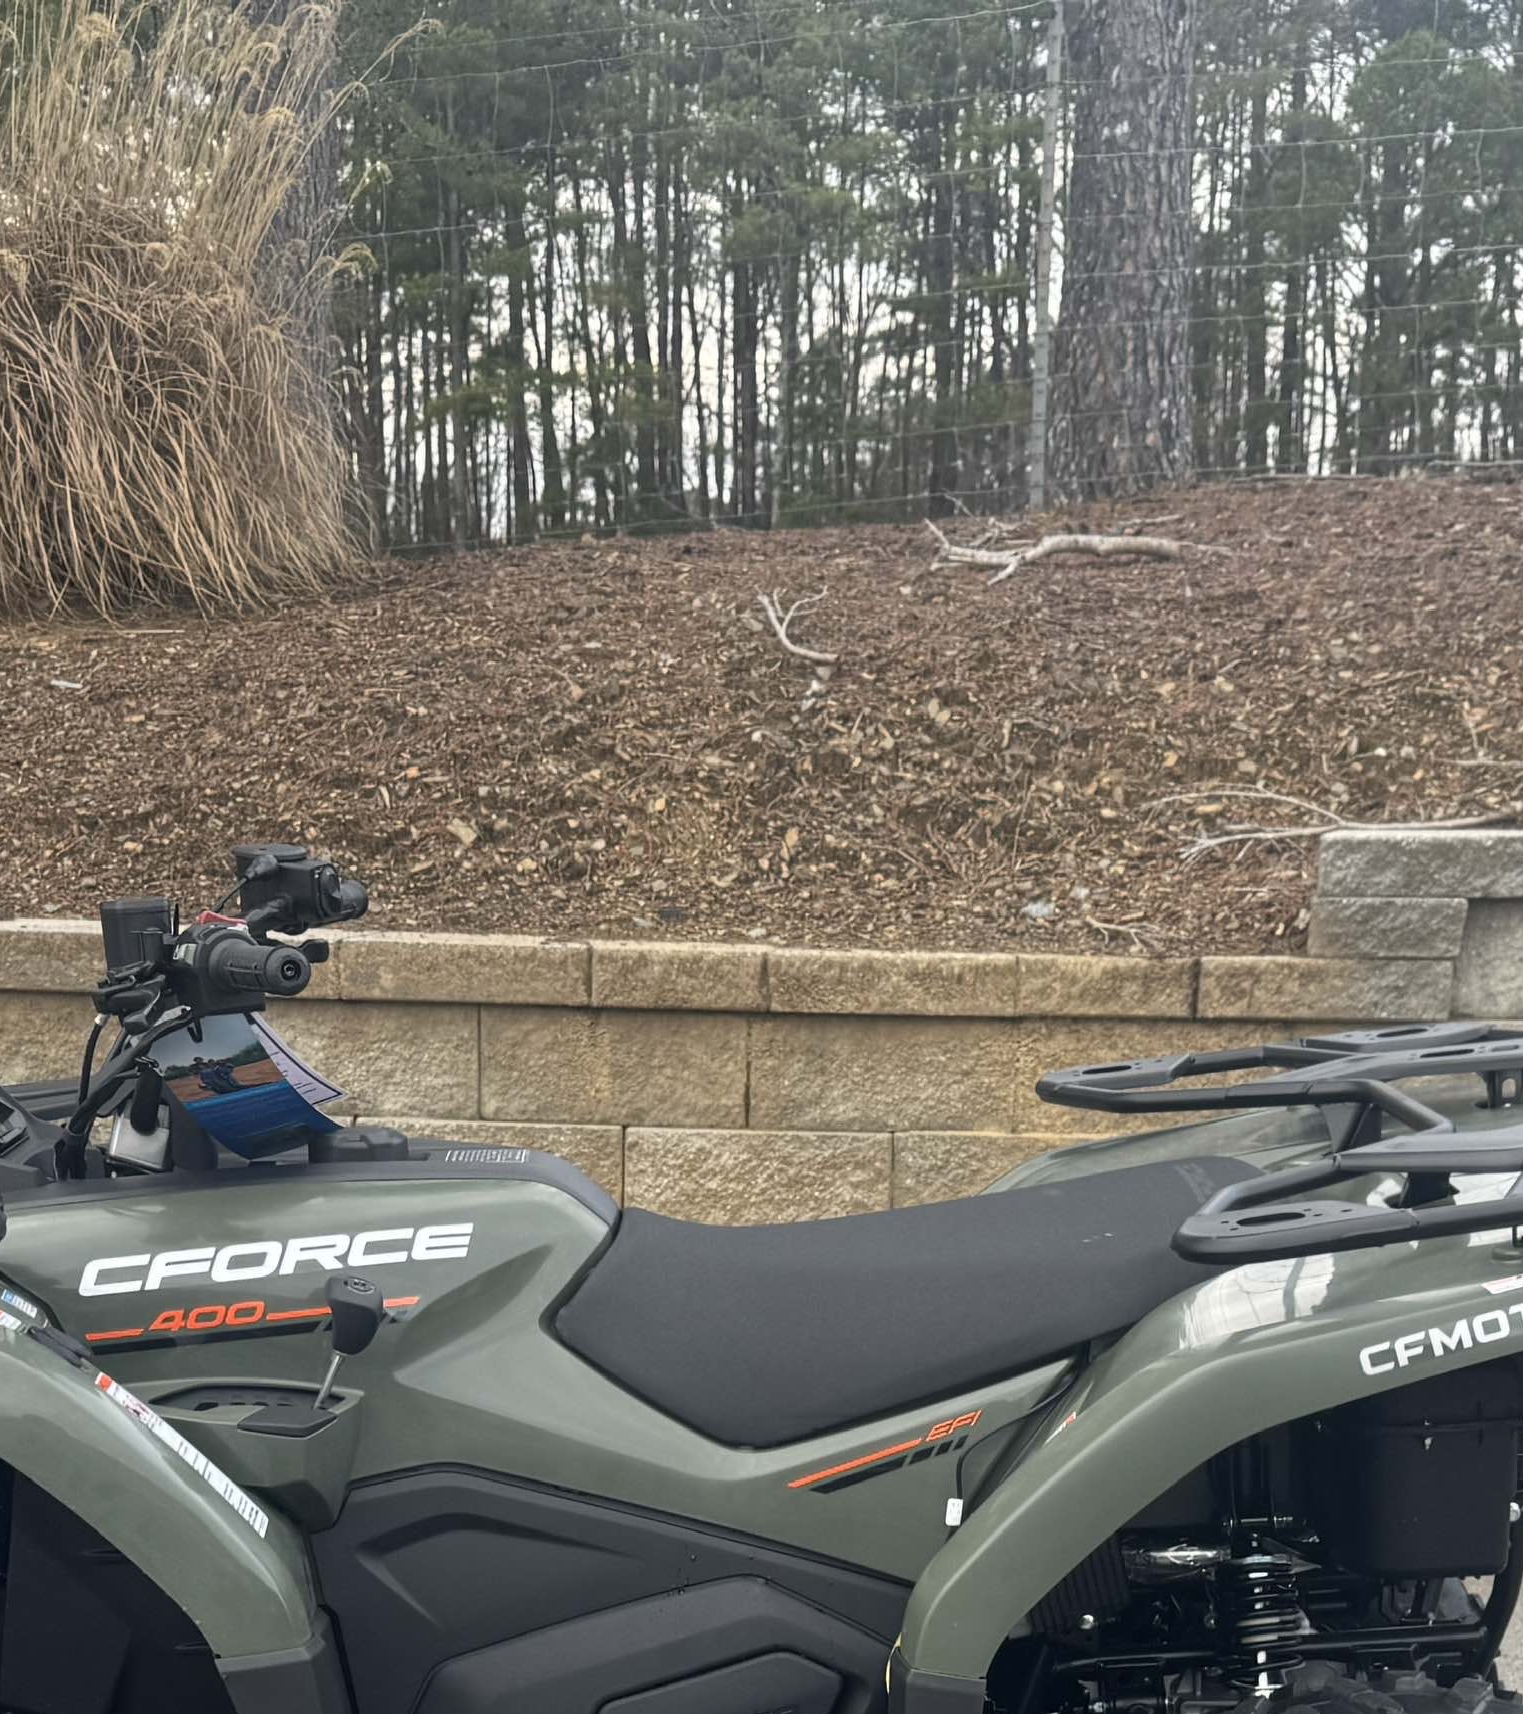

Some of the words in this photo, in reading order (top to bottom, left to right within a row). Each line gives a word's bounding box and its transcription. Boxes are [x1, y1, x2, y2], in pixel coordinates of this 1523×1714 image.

[78, 1222, 474, 1297] CFORCE
[149, 1301, 266, 1332] 400
[925, 1410, 982, 1441] EFI
